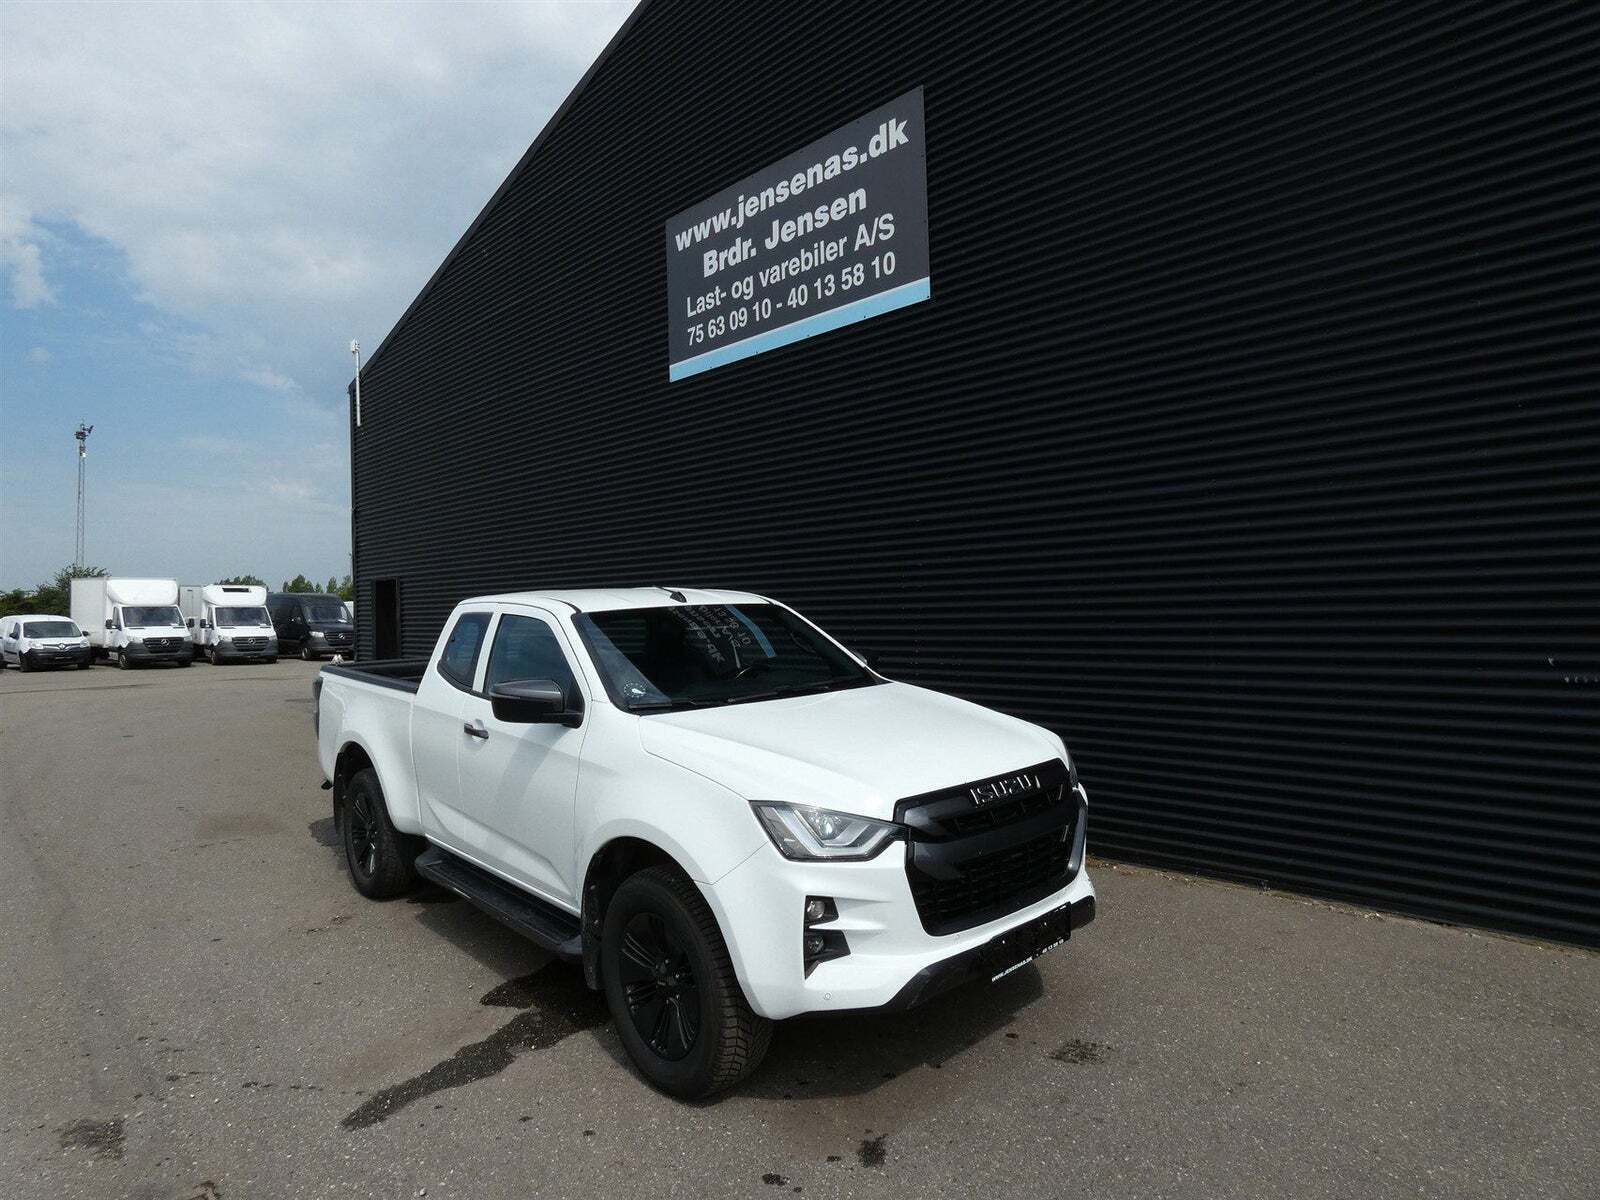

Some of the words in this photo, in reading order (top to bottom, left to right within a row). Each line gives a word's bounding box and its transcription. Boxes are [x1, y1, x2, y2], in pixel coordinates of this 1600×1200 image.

[674, 117, 910, 252] www.jensenas.dk
[686, 284, 727, 318] Last-
[731, 275, 754, 301] og
[758, 236, 848, 288] varebiler
[853, 212, 895, 252] A/S
[703, 237, 758, 278] Brdr.
[764, 187, 868, 250] Jensen
[687, 322, 705, 346] 75
[707, 315, 726, 339] 63
[729, 306, 748, 331] 09
[752, 297, 772, 322] 10
[787, 284, 809, 309] 40
[813, 273, 836, 300] 13
[841, 262, 865, 291] 58
[871, 251, 896, 279] 10
[969, 774, 1041, 805] ISUZU
